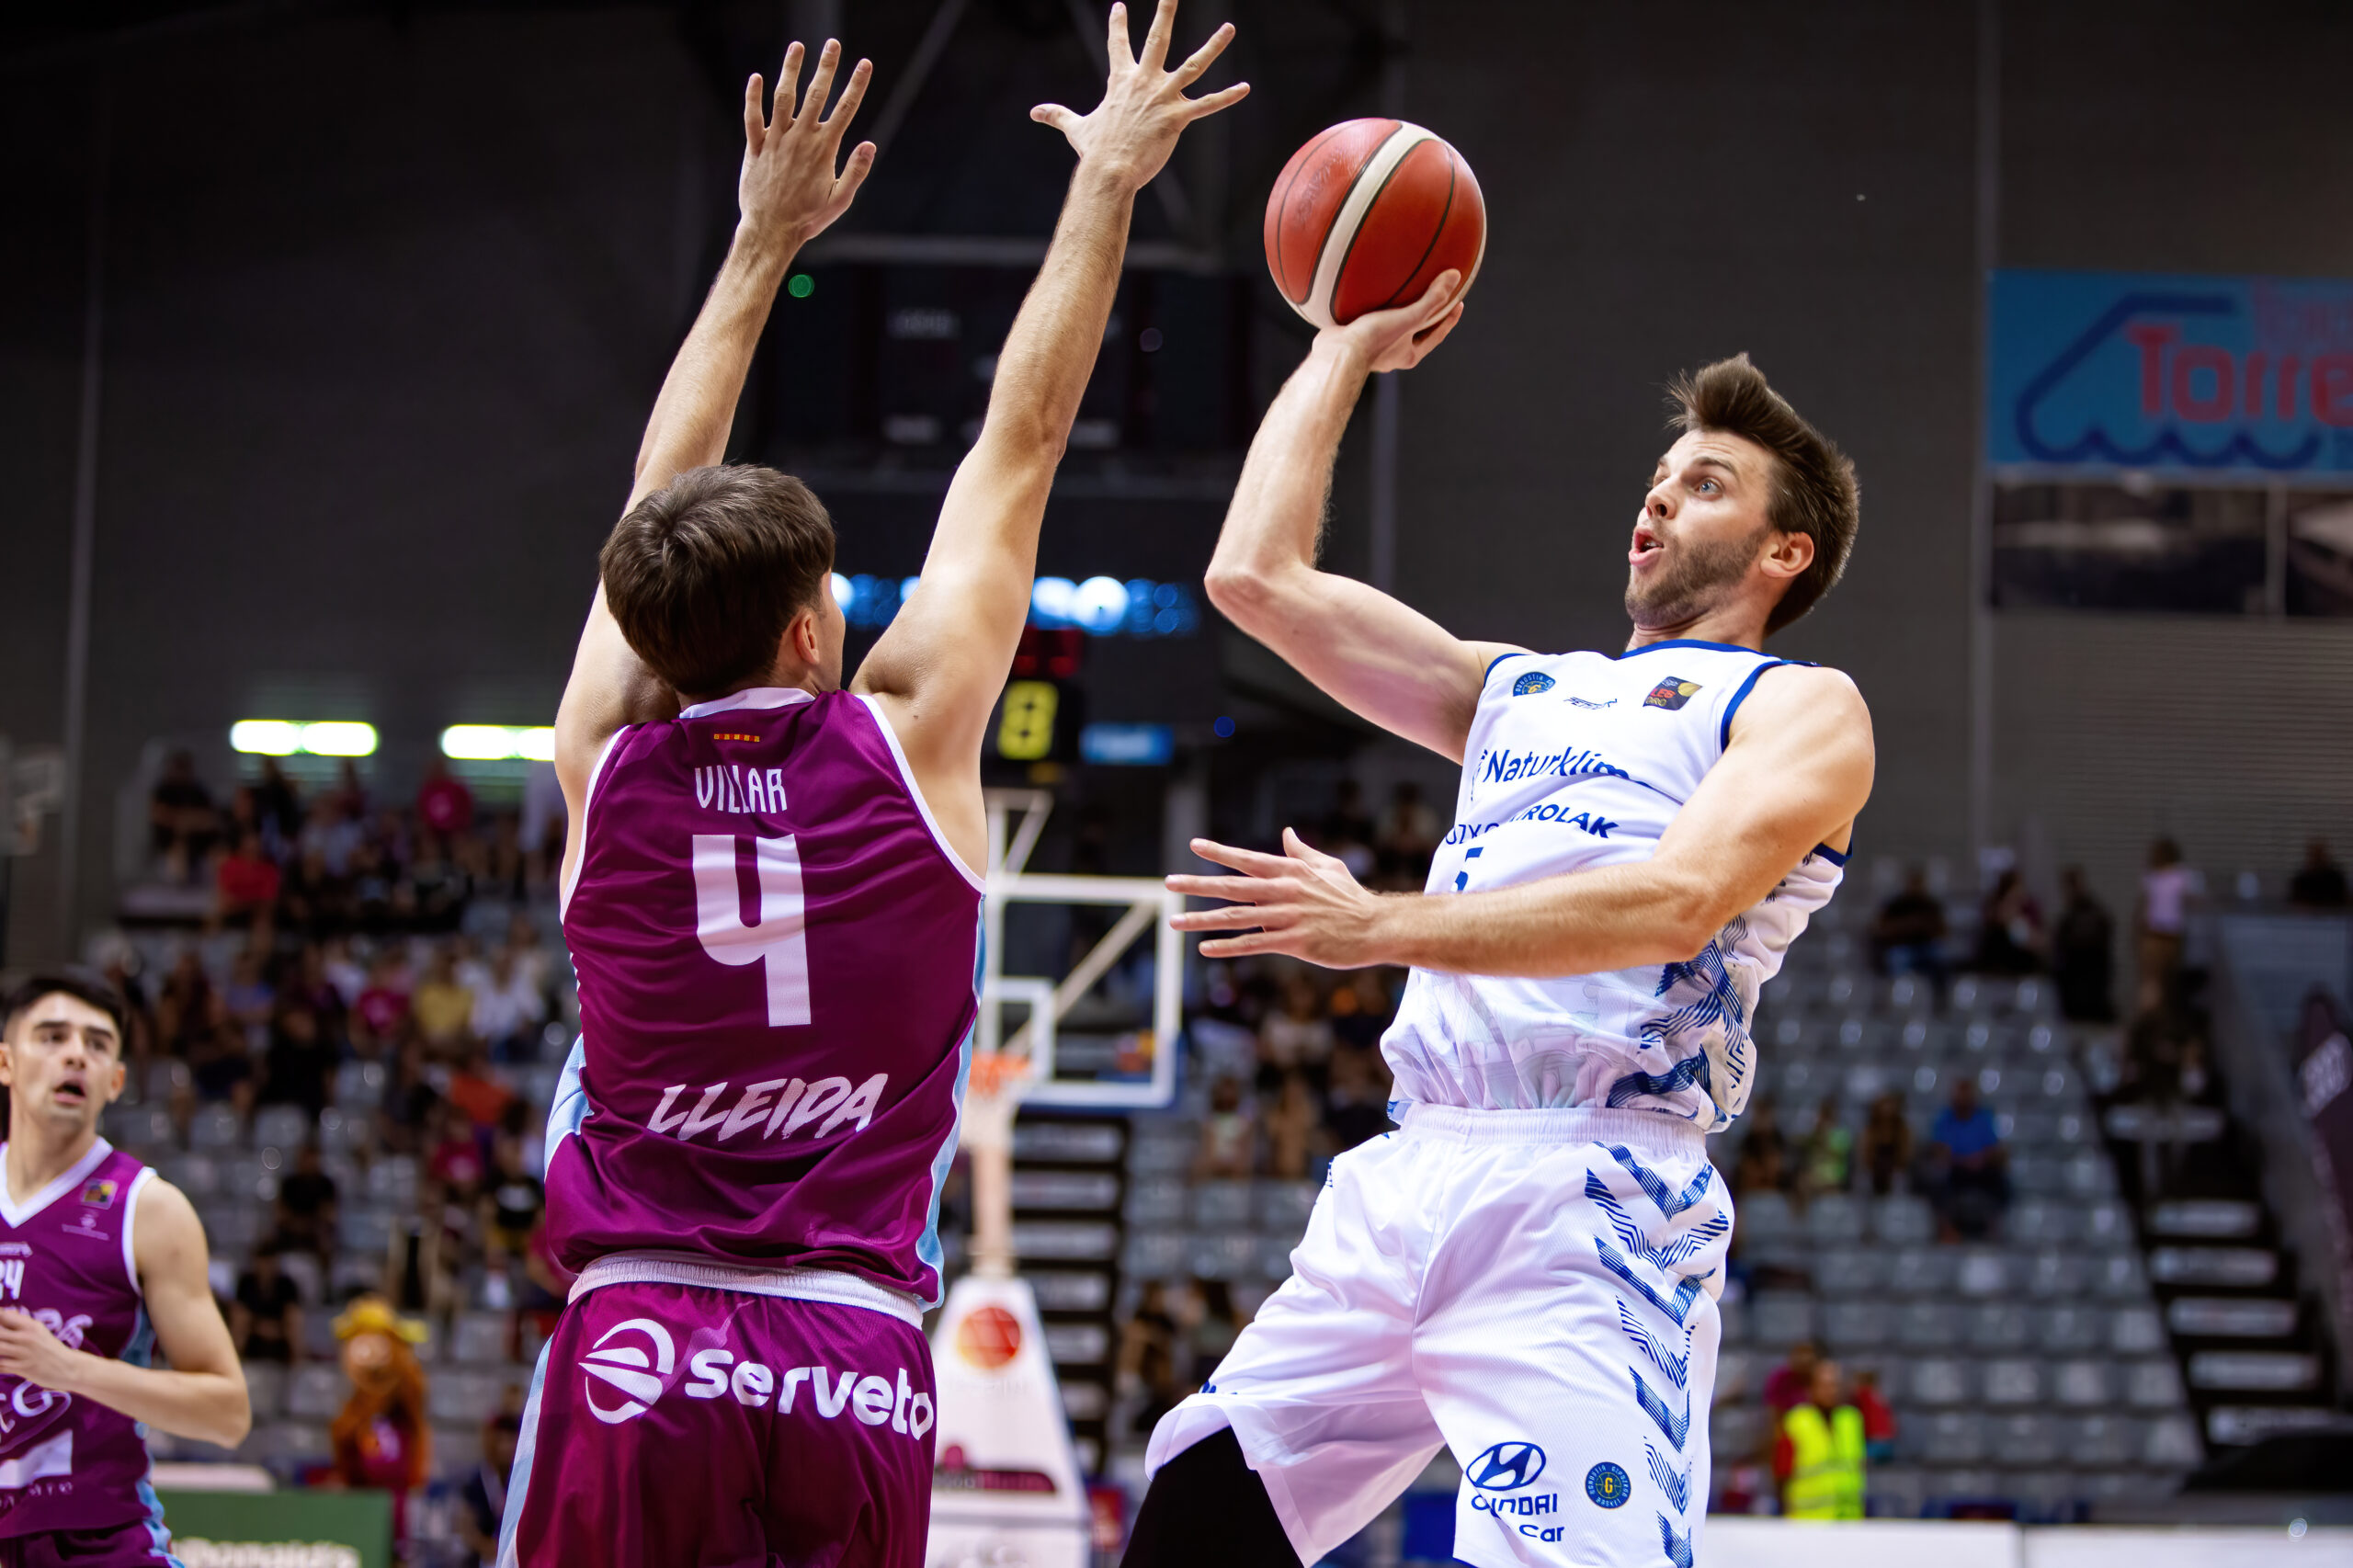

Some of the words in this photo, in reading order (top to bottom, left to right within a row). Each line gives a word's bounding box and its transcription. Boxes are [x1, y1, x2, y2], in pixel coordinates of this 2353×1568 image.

[997, 680, 1059, 761] 8
[695, 765, 788, 813] VILLAR
[1483, 746, 1656, 790] Naturklim
[692, 834, 812, 1027] 4
[647, 1073, 889, 1142] LLEIDA
[685, 1348, 935, 1440] serveto
[1605, 1477, 1613, 1494] G
